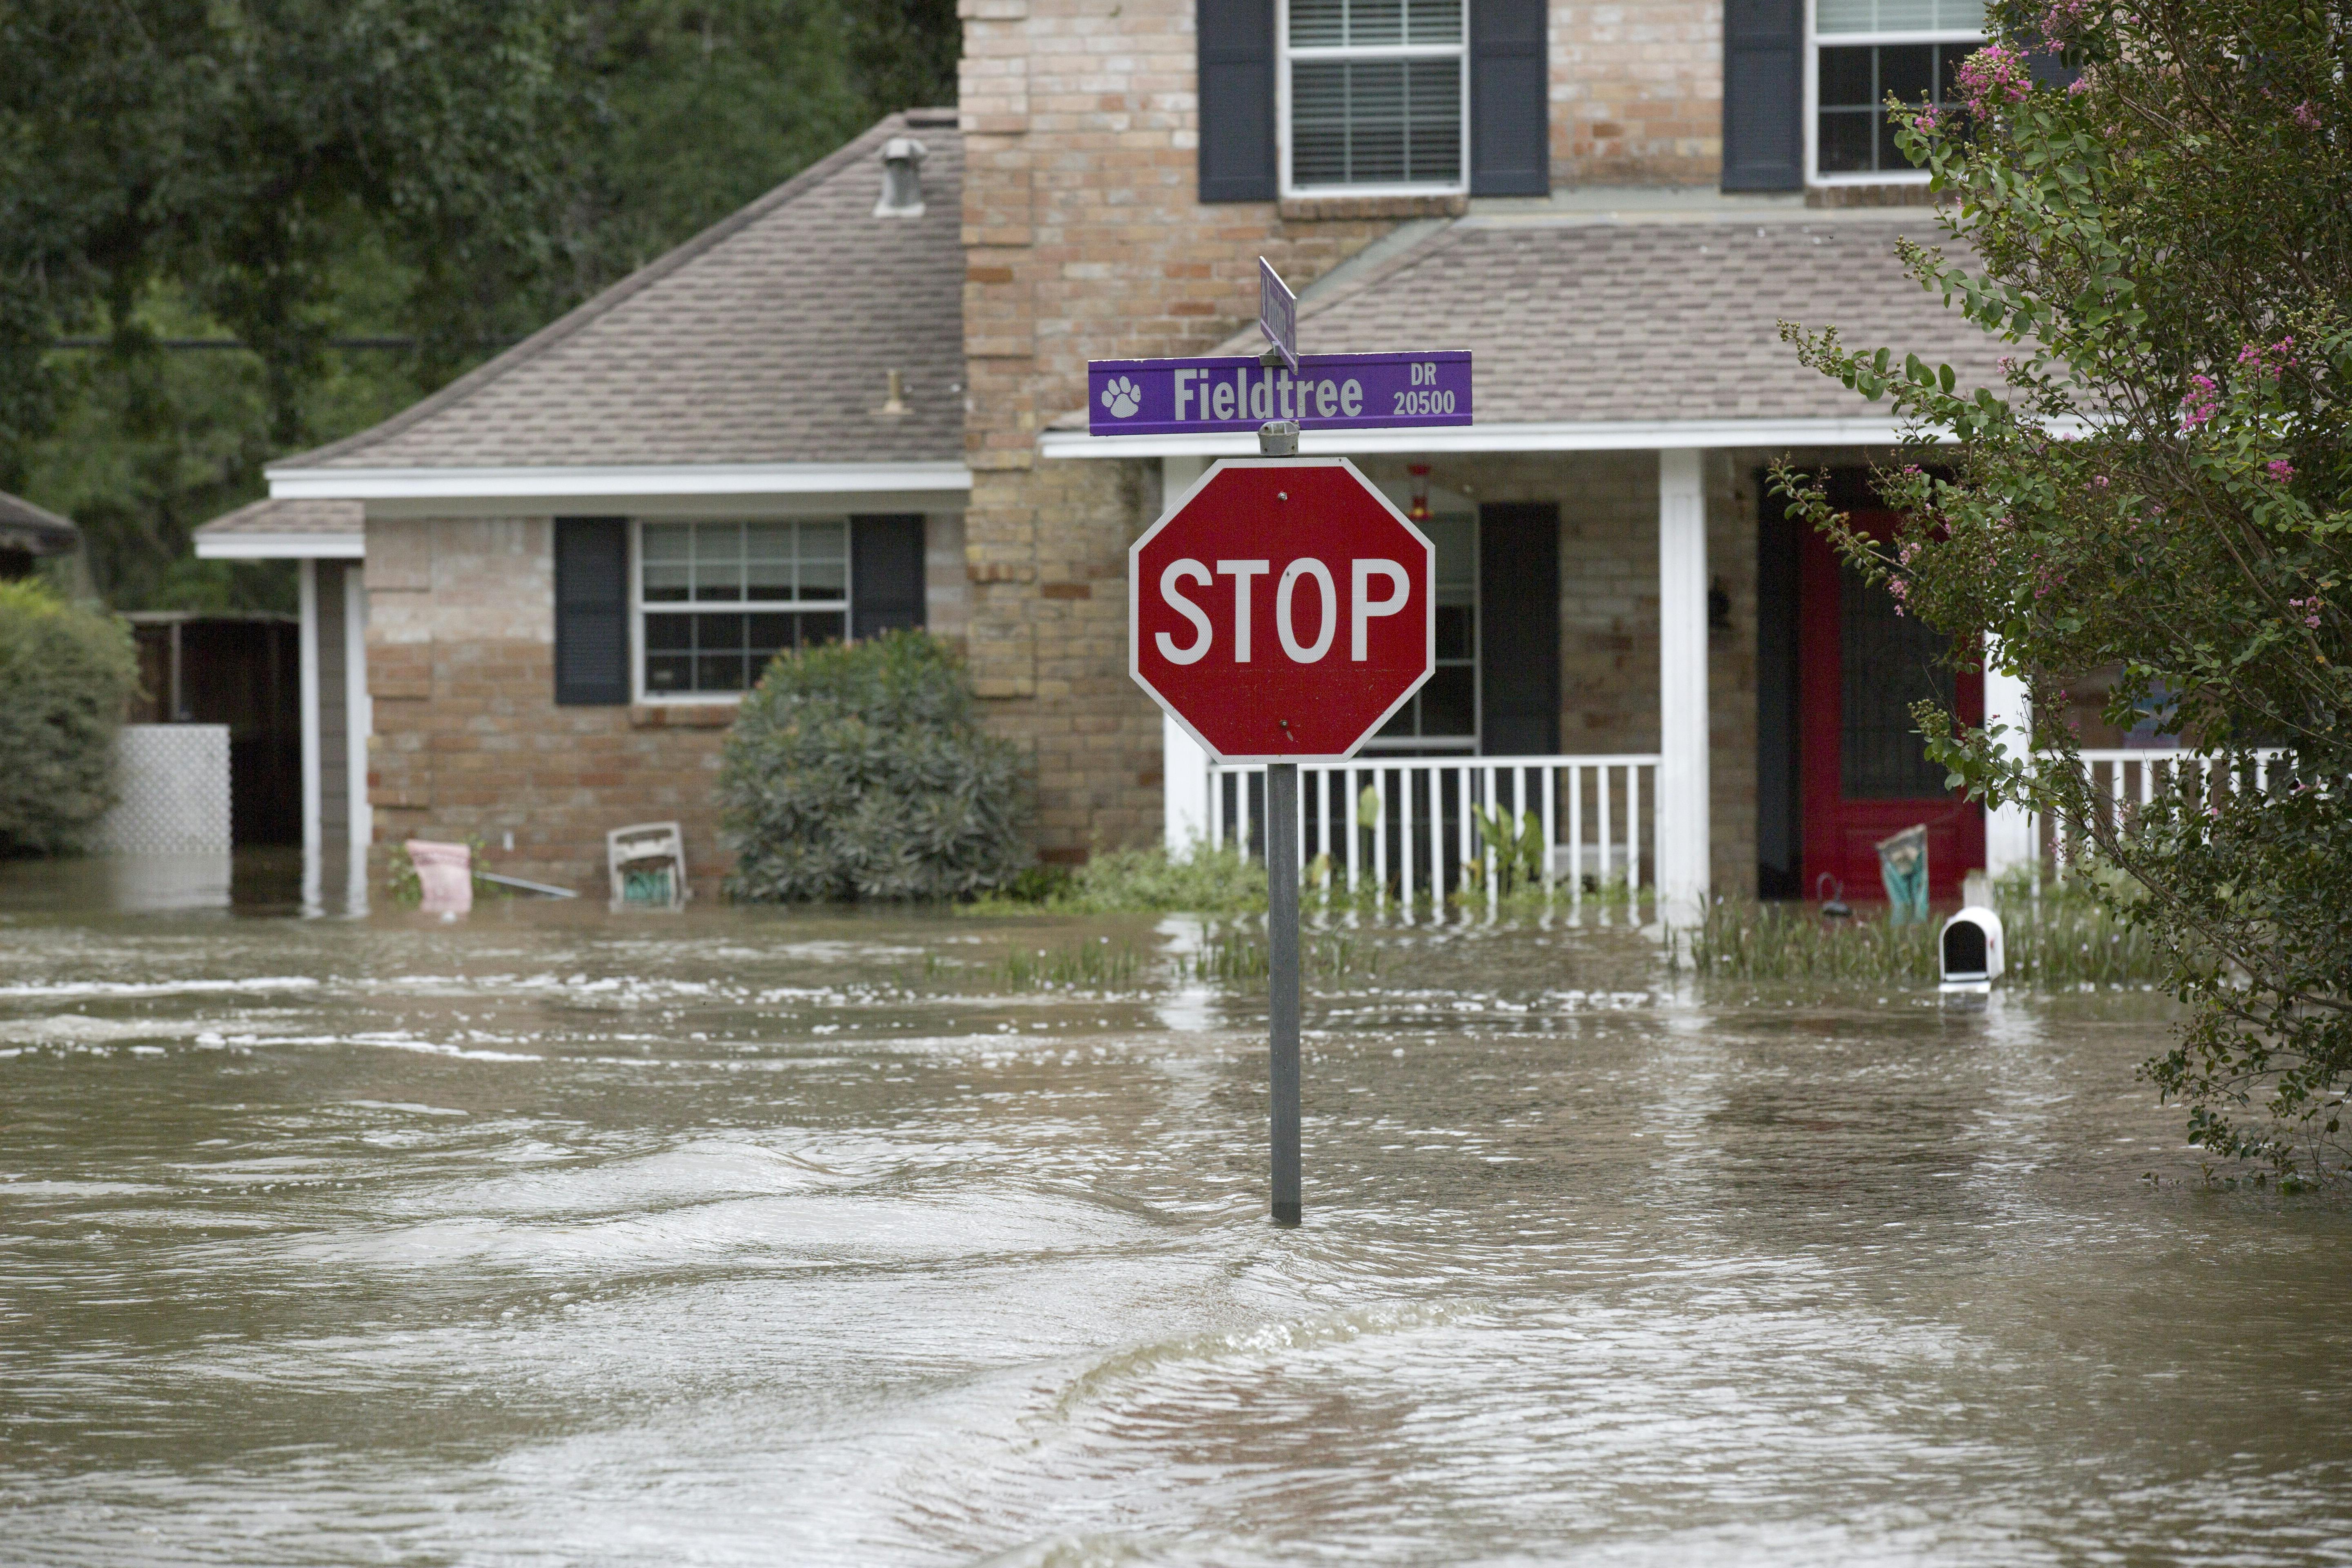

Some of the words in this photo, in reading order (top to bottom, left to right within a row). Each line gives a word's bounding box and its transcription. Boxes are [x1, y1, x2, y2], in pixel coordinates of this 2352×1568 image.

[1411, 362, 1437, 385] DR
[1174, 368, 1363, 420] Fieldtree
[1394, 390, 1455, 415] 20500
[1155, 557, 1410, 665] STOP
